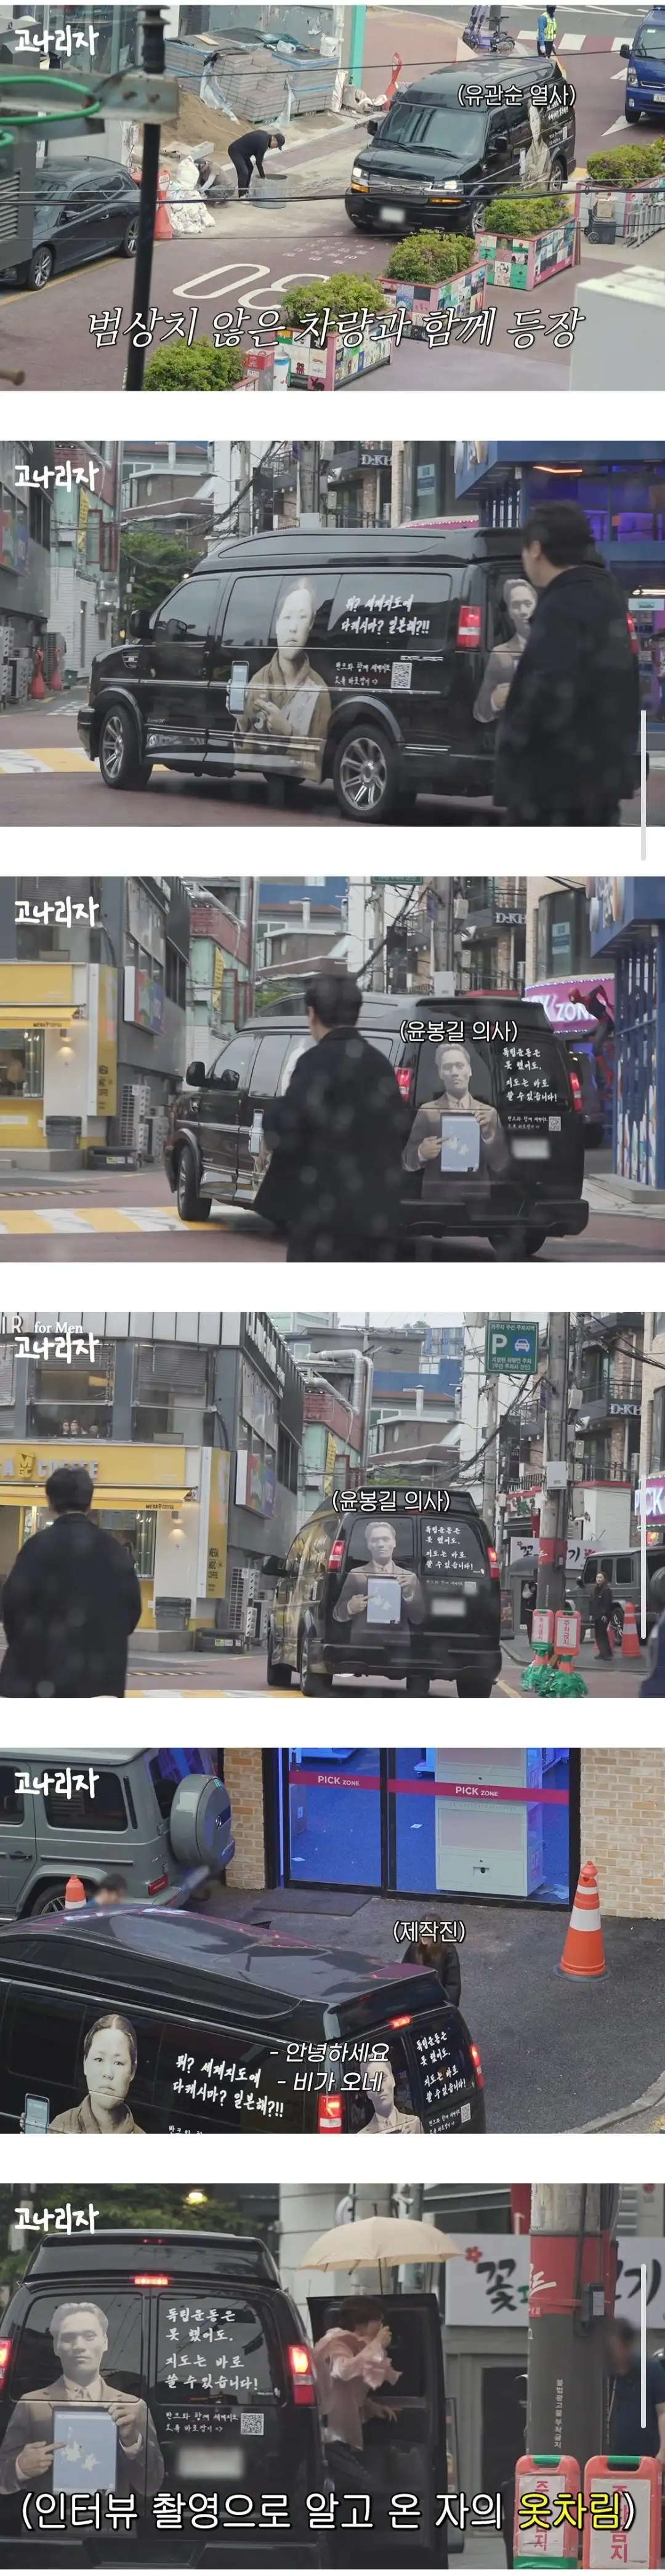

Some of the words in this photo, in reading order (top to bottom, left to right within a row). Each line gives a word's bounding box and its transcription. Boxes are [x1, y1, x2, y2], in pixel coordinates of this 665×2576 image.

[365, 594, 414, 612] 세계지도에
[341, 616, 384, 635] 다케시마?
[556, 1002, 597, 1021] ZON
[502, 1047, 541, 1057] 독립운동은
[504, 1060, 512, 1069] 못
[506, 1077, 529, 1087] 지도는
[533, 1079, 549, 1088] 바로
[34, 1321, 52, 1334] for
[55, 1322, 83, 1334] Men
[492, 1334, 507, 1354] P
[425, 1526, 461, 1534] 독립운동은
[425, 1549, 447, 1558] 지도는
[451, 1551, 467, 1559] 바로
[318, 1776, 341, 1784] PICK
[455, 1786, 478, 1795] PICK
[416, 2031, 447, 2051] 독립운동은
[420, 2055, 427, 2066] 못
[175, 2053, 195, 2074] 뭐?
[200, 2058, 261, 2088] 세계지도에
[424, 2071, 443, 2087] 지도는
[446, 2064, 459, 2078] 바로
[173, 2078, 227, 2107] 다케시마?
[233, 2090, 284, 2117] 일본해?!!
[476, 2258, 517, 2314] 꽃
[616, 2259, 661, 2306] 기
[166, 2308, 236, 2322] 독립운동은
[166, 2327, 179, 2341] 못
[165, 2353, 207, 2369] 지도는
[216, 2355, 244, 2369] 바로
